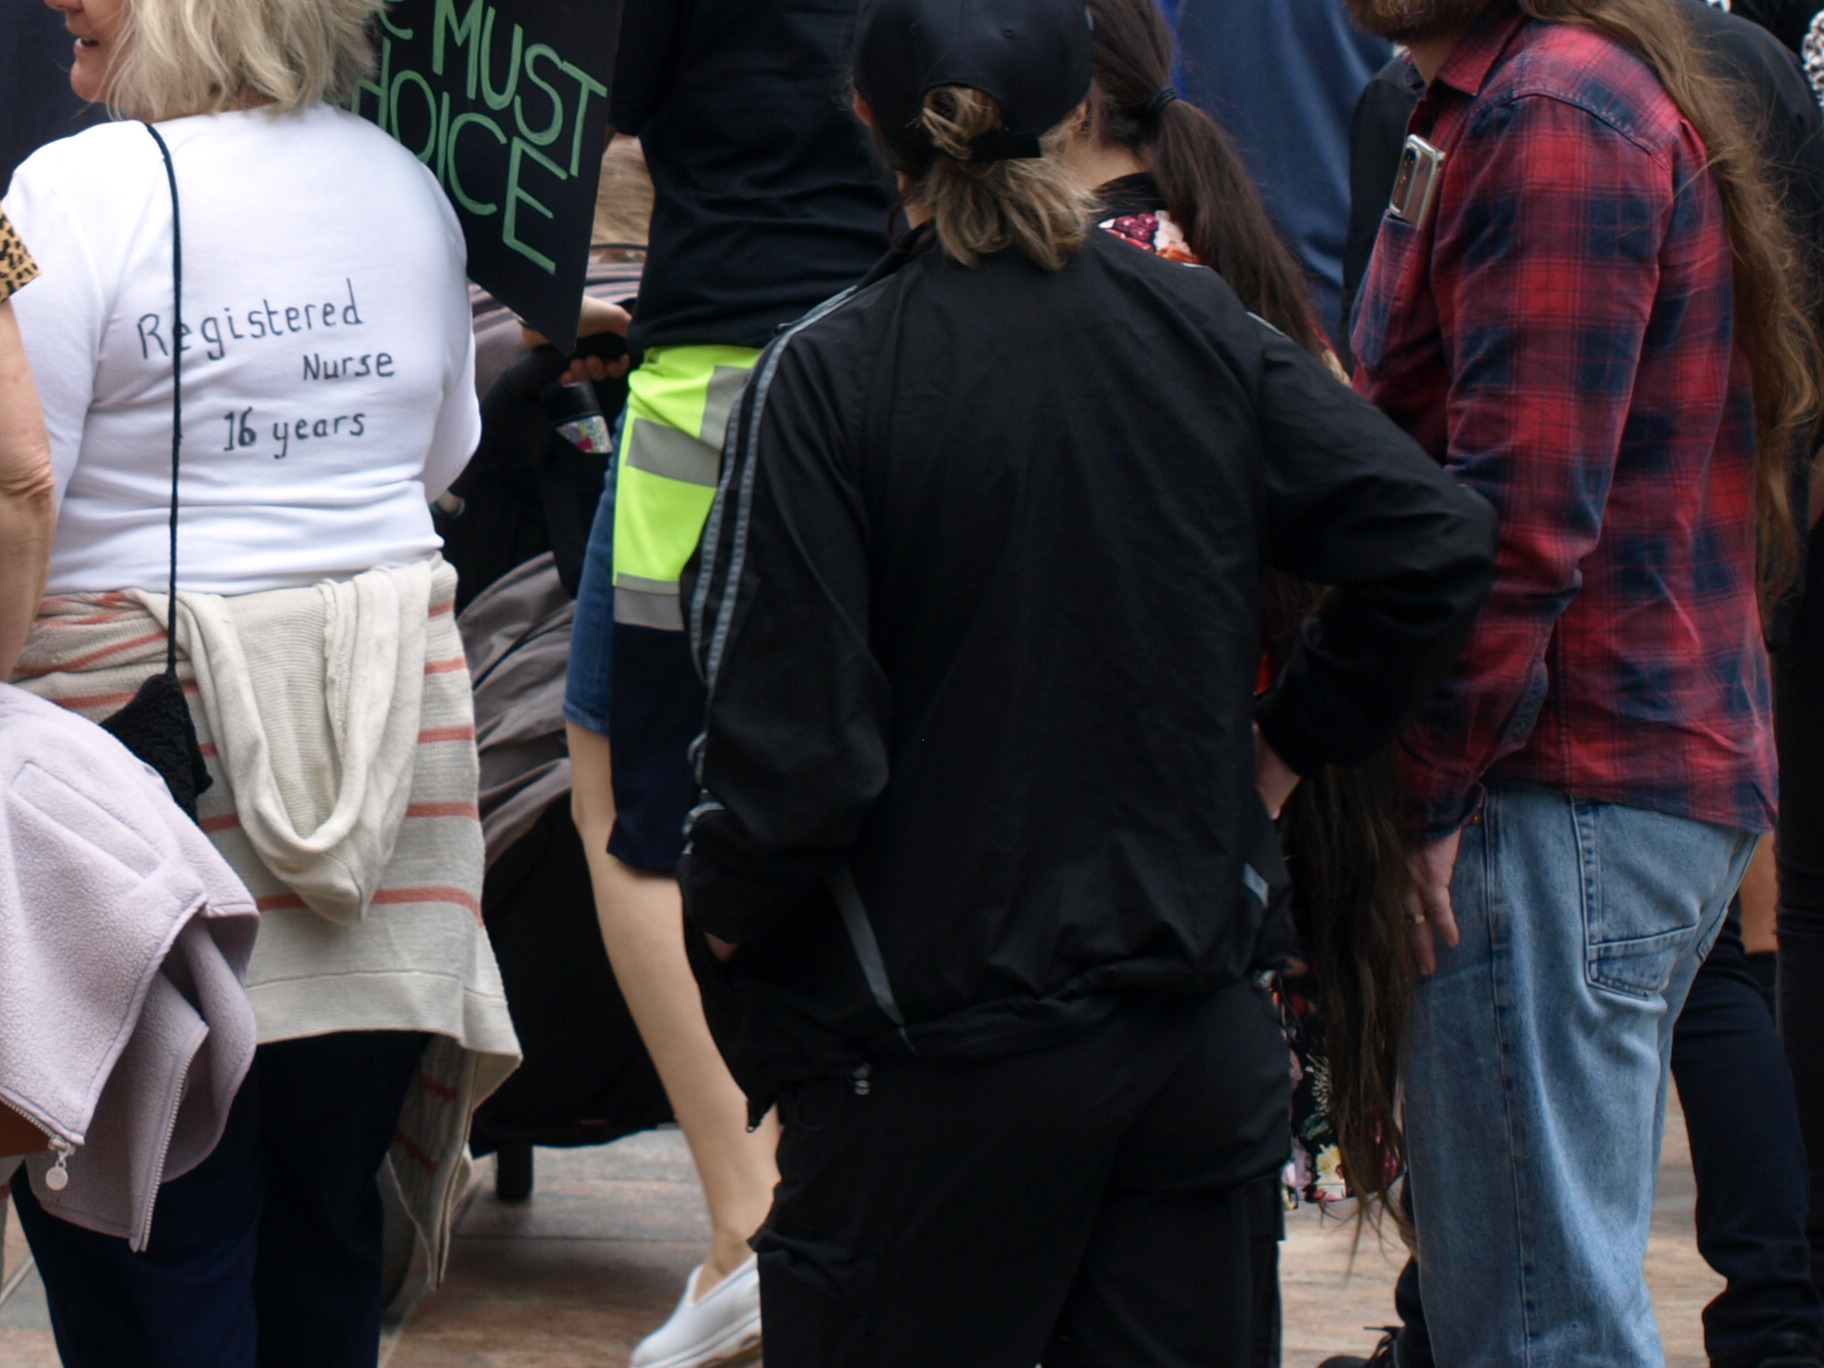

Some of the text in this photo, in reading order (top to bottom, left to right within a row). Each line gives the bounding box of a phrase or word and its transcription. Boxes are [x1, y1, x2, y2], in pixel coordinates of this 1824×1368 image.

[350, 37, 557, 275] HOICE
[136, 277, 364, 361] Registered
[302, 351, 396, 381] Nurse
[223, 406, 366, 460] 16 years
